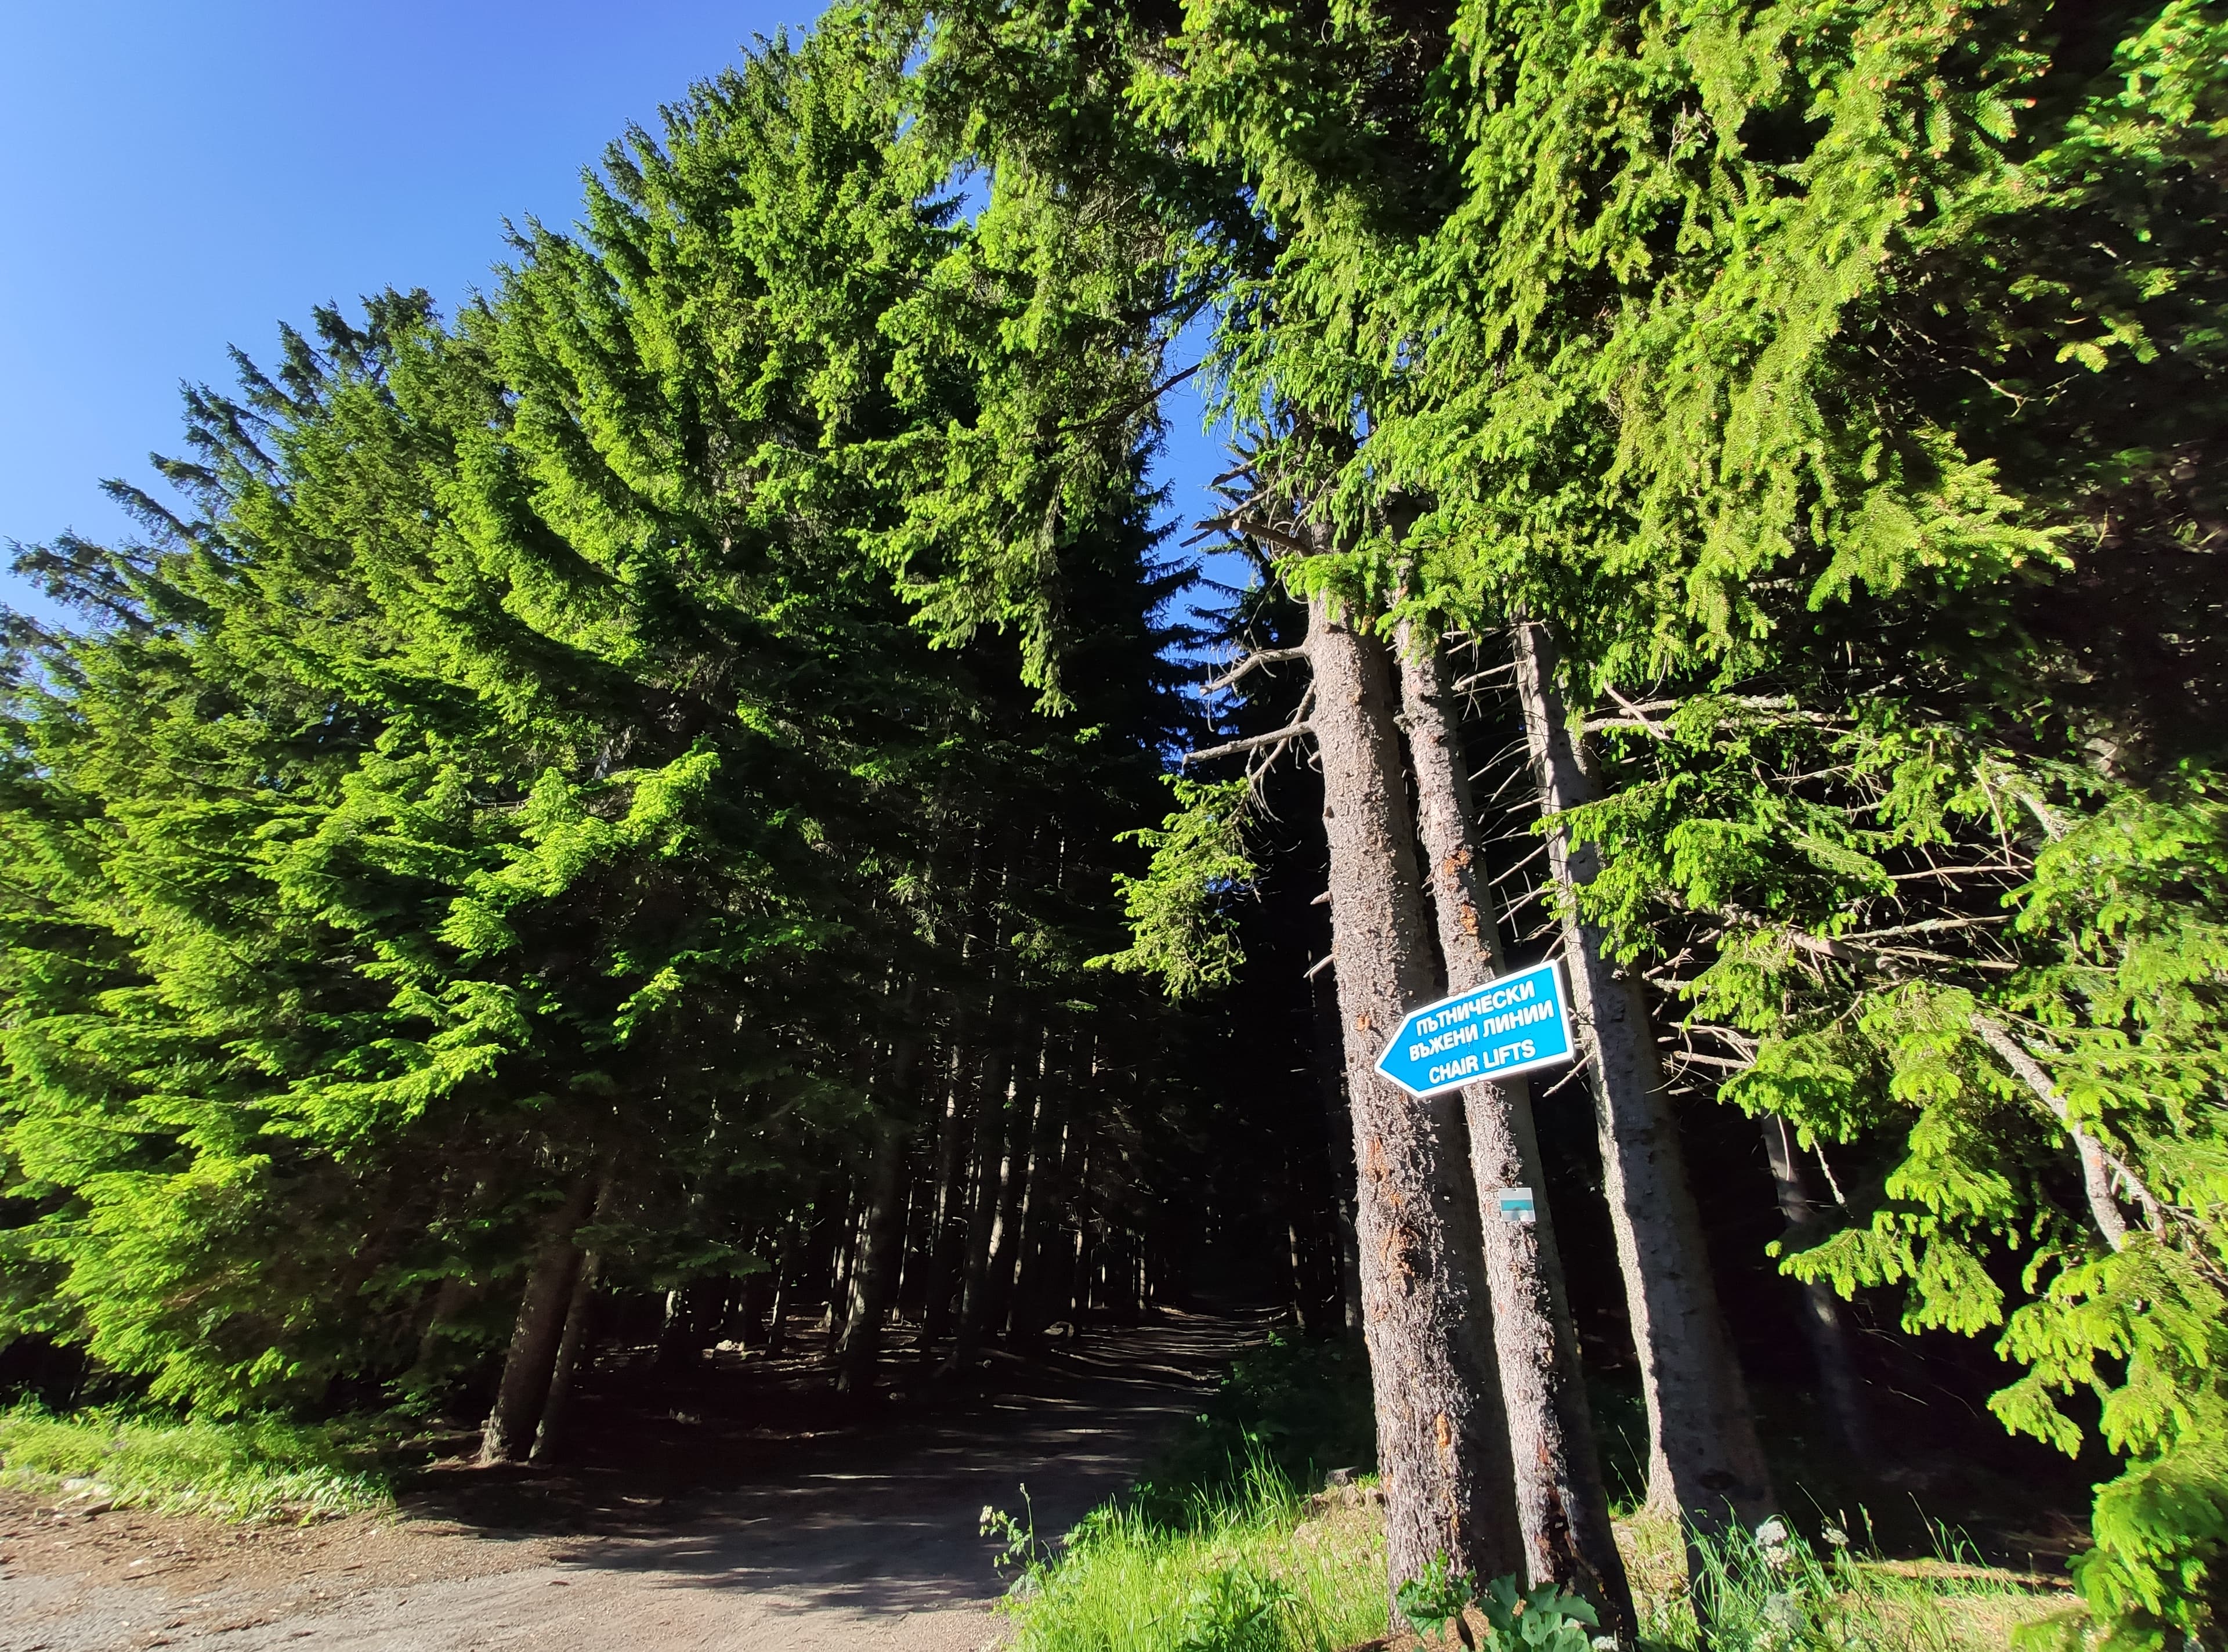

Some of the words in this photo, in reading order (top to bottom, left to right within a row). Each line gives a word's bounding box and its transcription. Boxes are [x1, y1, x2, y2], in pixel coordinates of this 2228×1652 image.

[1409, 1024, 1478, 1061] ВЪЖЕНИ
[1482, 1000, 1554, 1038] ЛИНИИ
[1416, 980, 1535, 1036] ПЪТНИЧЕСКИ
[1429, 1055, 1479, 1084] CHAIR
[1483, 1039, 1536, 1069] LIFTS
